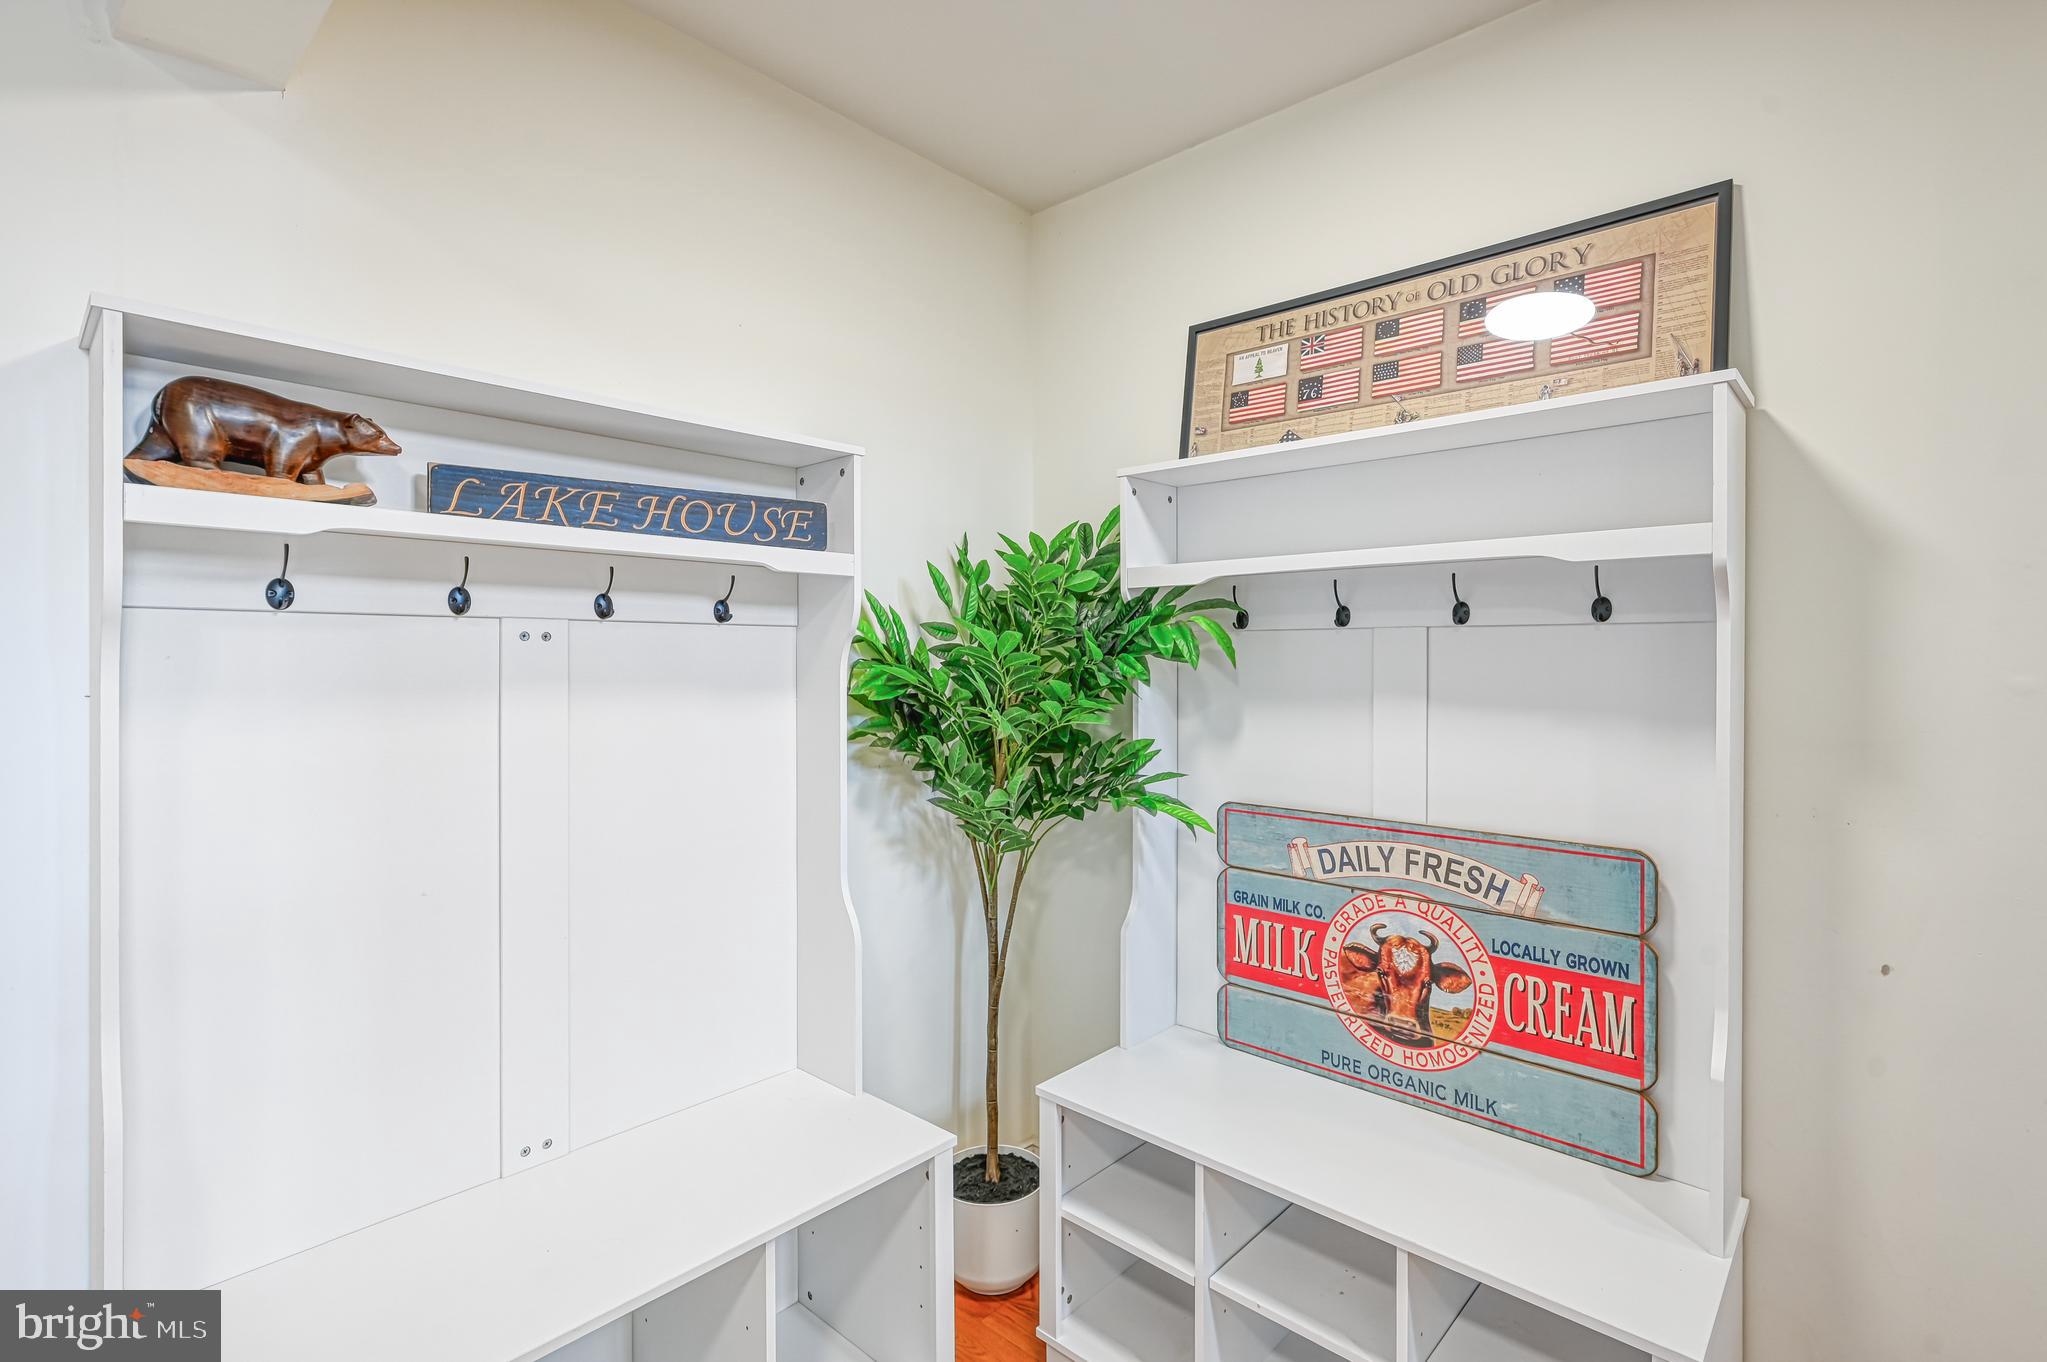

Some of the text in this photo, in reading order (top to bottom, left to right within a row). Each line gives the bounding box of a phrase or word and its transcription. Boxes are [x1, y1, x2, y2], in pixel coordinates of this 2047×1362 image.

[1256, 243, 1593, 342] THE HISTORY OF OLD GLORY
[1302, 388, 1318, 400] 76
[440, 477, 814, 543] LAKE HOUSE
[1233, 889, 1326, 921] GRAIN MILK CO.
[1317, 845, 1510, 906] DAILY FRESH
[1232, 914, 1321, 982] MILK
[1334, 894, 1488, 964] GRADE A QUALITY
[1491, 938, 1630, 980] LOCALLY GROWN
[1323, 948, 1496, 1068] PASTEURIZED HOMOGENIZED
[1503, 972, 1638, 1061] CREAM
[1321, 1050, 1498, 1117] PURE ORGANIC MILK
